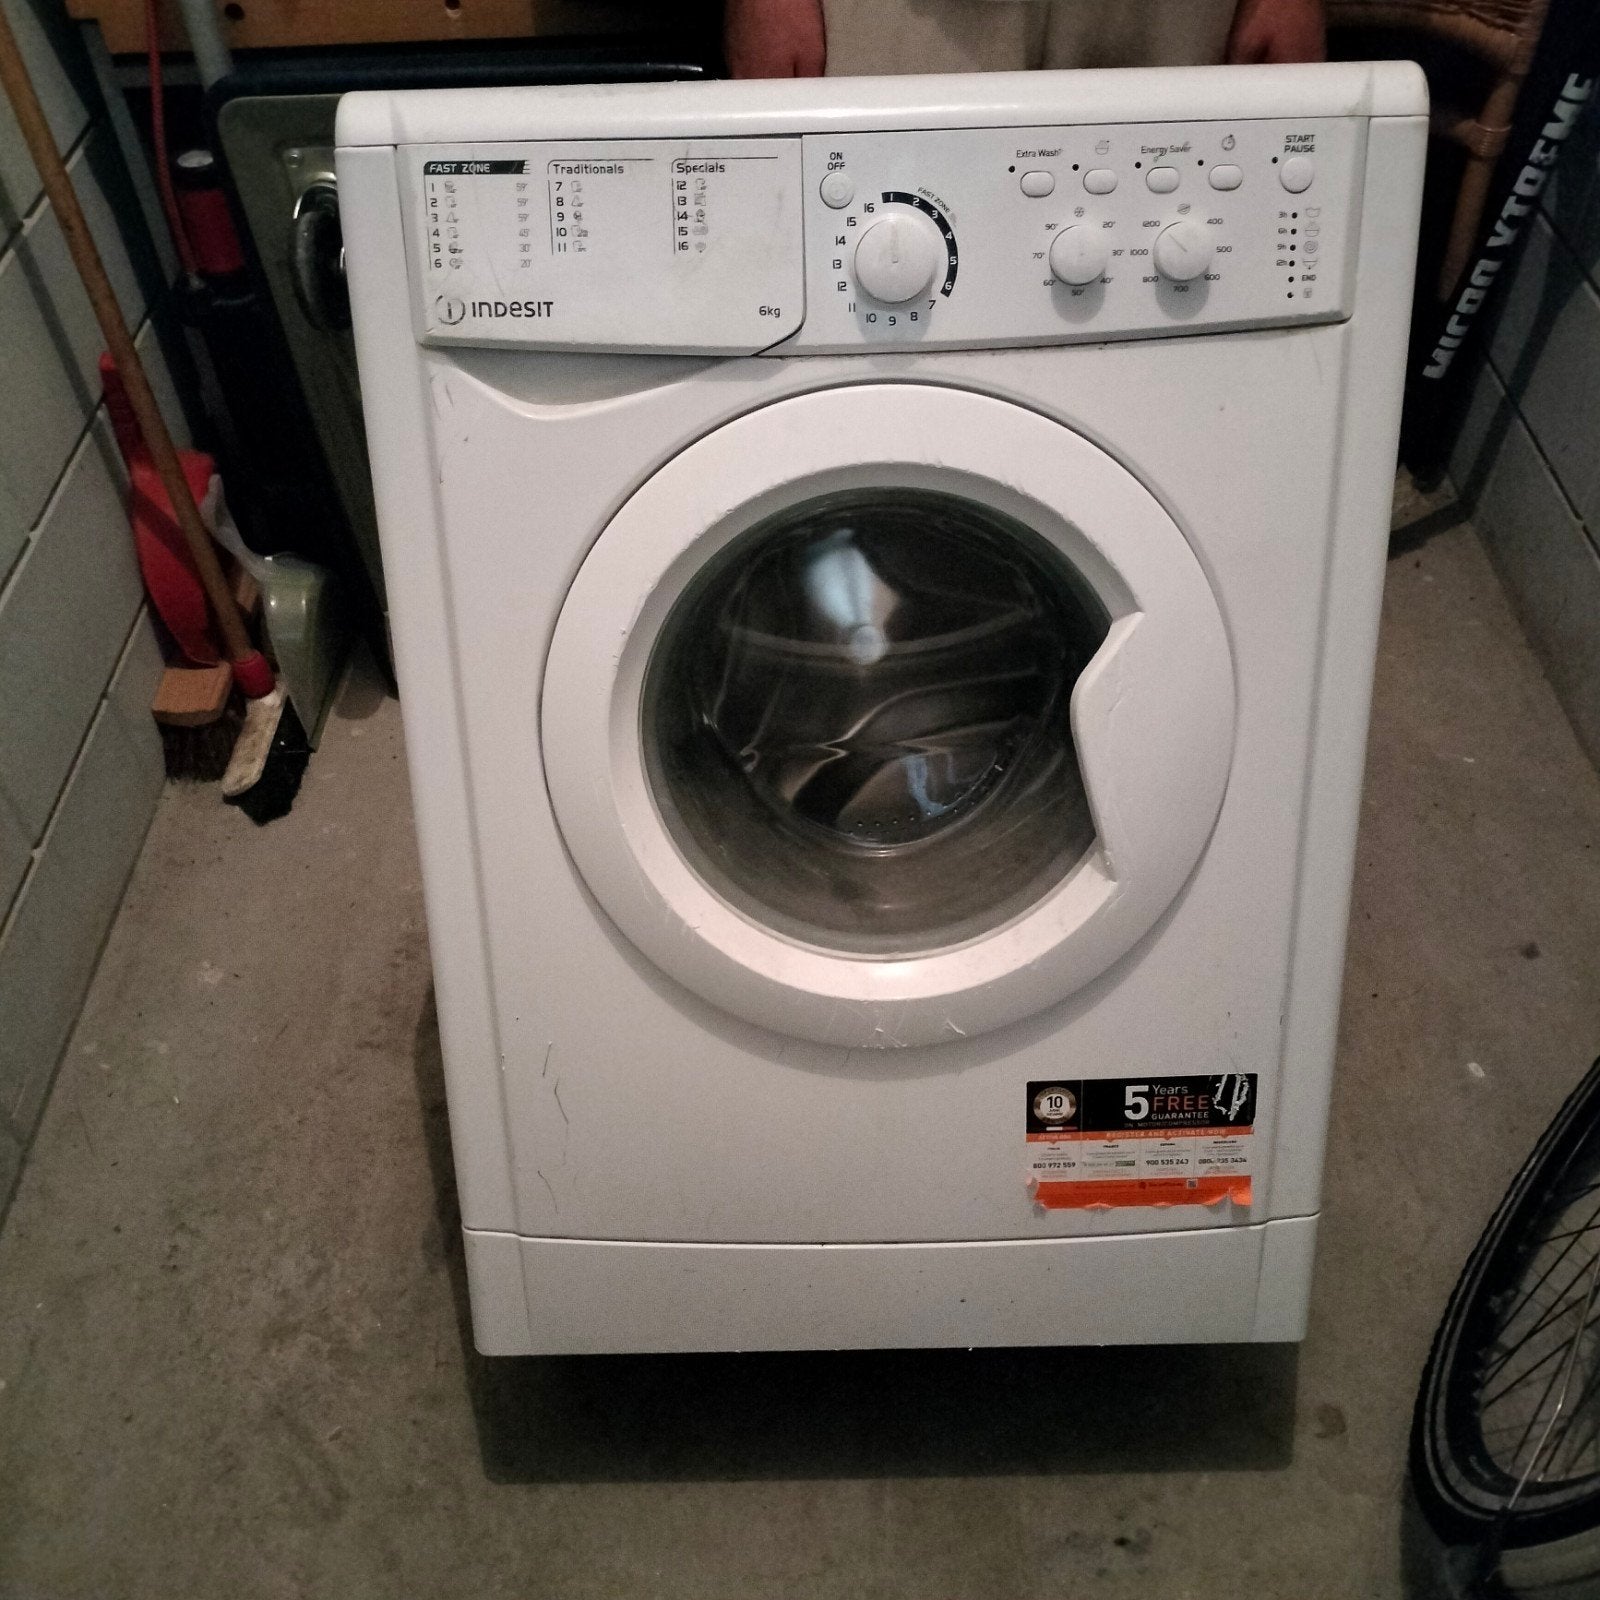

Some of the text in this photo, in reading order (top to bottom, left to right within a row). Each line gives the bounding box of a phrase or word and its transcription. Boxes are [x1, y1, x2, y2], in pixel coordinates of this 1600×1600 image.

[1286, 134, 1316, 143] START
[1016, 149, 1036, 158] Extra
[1141, 145, 1168, 156] Energy
[1284, 145, 1315, 153] PAUSE
[829, 152, 843, 160] ON
[429, 163, 490, 173] FAST ZONE
[553, 164, 624, 174] Traditionals
[676, 162, 725, 175] Specials
[827, 162, 845, 170] OFF
[555, 182, 562, 191] 7
[676, 181, 687, 190] 12
[430, 198, 438, 207] 2
[556, 197, 564, 206] 8
[677, 196, 686, 206] 13
[913, 197, 920, 207] 2
[918, 187, 950, 213] FAST ZONE
[864, 203, 875, 213] 16
[431, 213, 438, 222] 3
[557, 212, 564, 221] 9
[677, 211, 688, 220] 14
[932, 209, 938, 219] 3
[847, 217, 857, 226] 15
[433, 229, 440, 237] 4
[556, 227, 567, 237] 10
[678, 227, 688, 236] 15
[945, 231, 953, 240] 4
[835, 236, 846, 245] 14
[433, 244, 441, 252] 5
[558, 243, 567, 252] 11
[678, 242, 688, 251] 16
[434, 259, 442, 268] 6
[833, 260, 842, 269] 13
[950, 257, 957, 265] 5
[838, 282, 847, 291] 12
[945, 281, 952, 290] 6
[849, 303, 856, 312] 11
[928, 300, 936, 310] 7
[759, 305, 781, 319] 6kg
[910, 312, 918, 321] 8
[866, 313, 877, 323] 10
[888, 316, 896, 326] 9
[1046, 1096, 1063, 1109] 10
[1124, 1084, 1189, 1120] 5 Years
[1153, 1095, 1210, 1111] FREE
[1151, 1112, 1209, 1120] GUARANTEE
